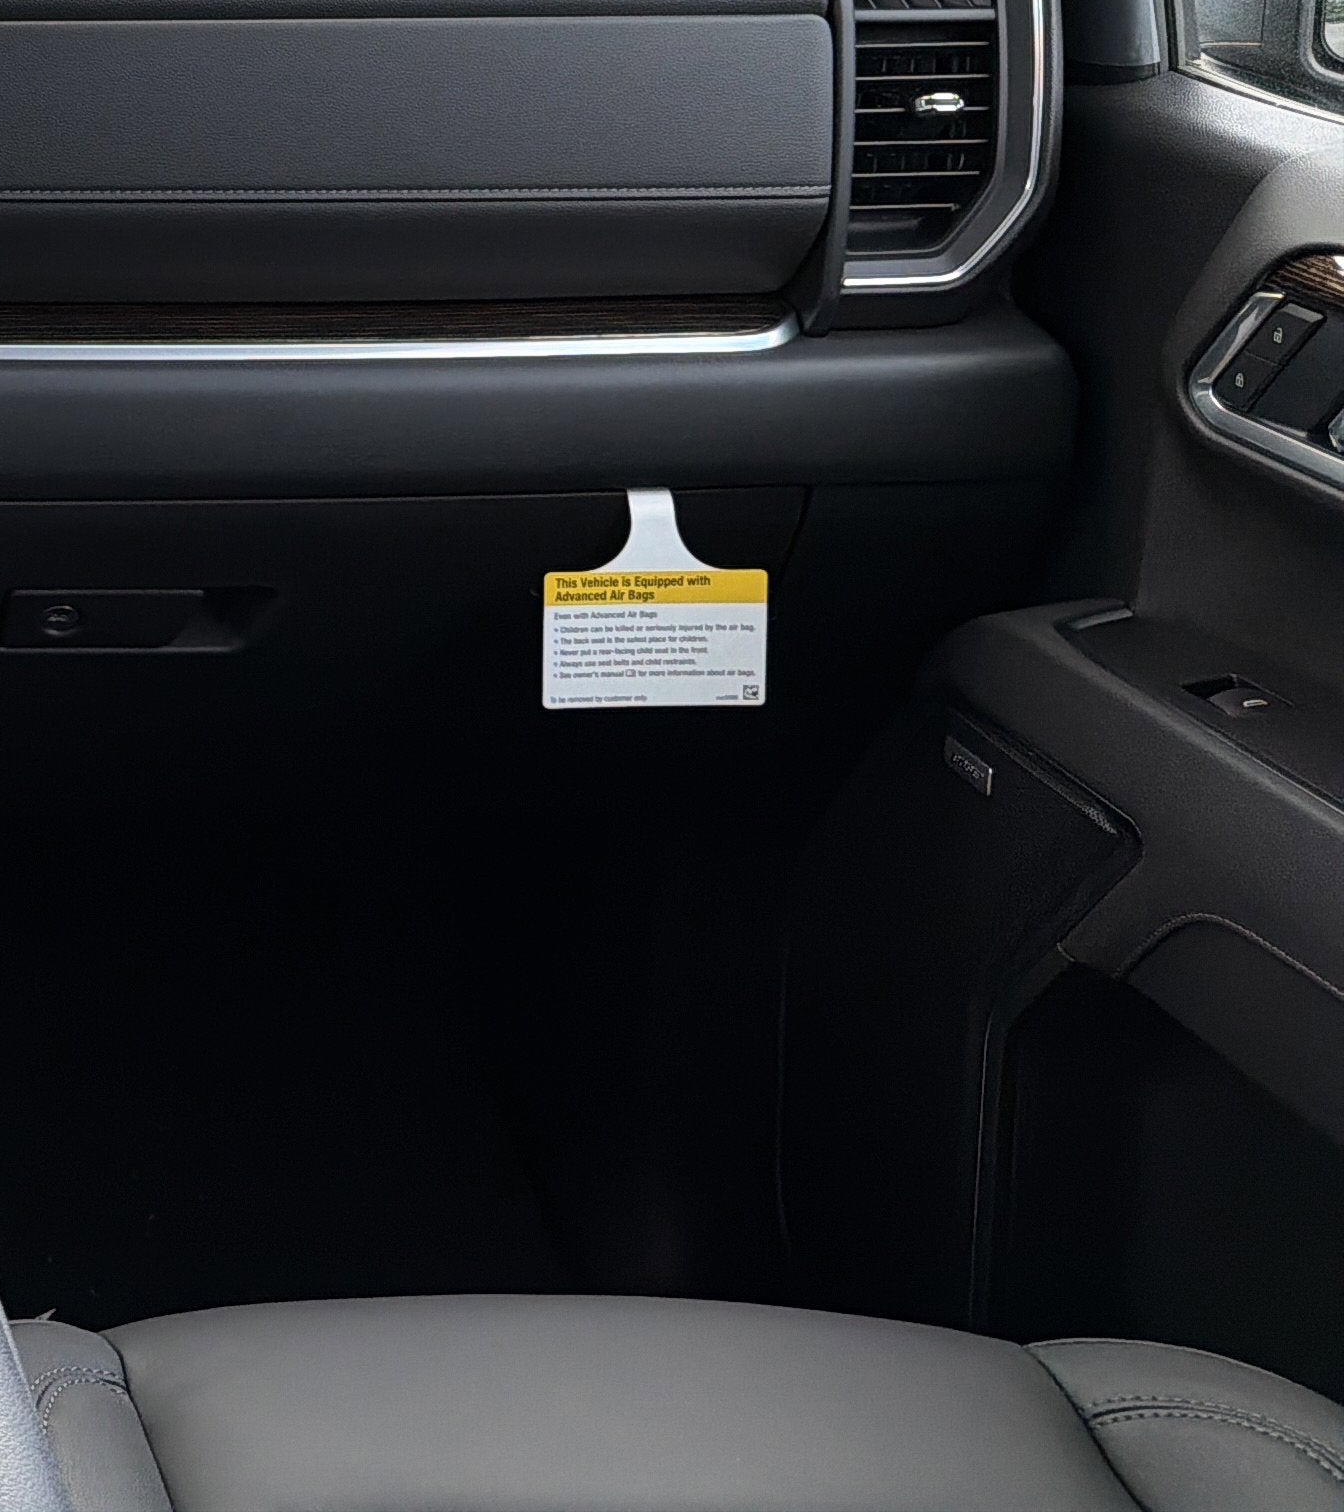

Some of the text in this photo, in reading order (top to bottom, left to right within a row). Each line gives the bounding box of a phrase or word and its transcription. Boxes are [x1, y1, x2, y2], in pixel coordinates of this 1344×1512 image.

[555, 578, 577, 588] This
[580, 577, 619, 587] Vehicle
[634, 576, 684, 588] Equipped
[687, 575, 711, 586] with
[555, 590, 655, 602] Advanced Air Bags
[639, 611, 657, 619] Bags
[705, 624, 713, 632] by
